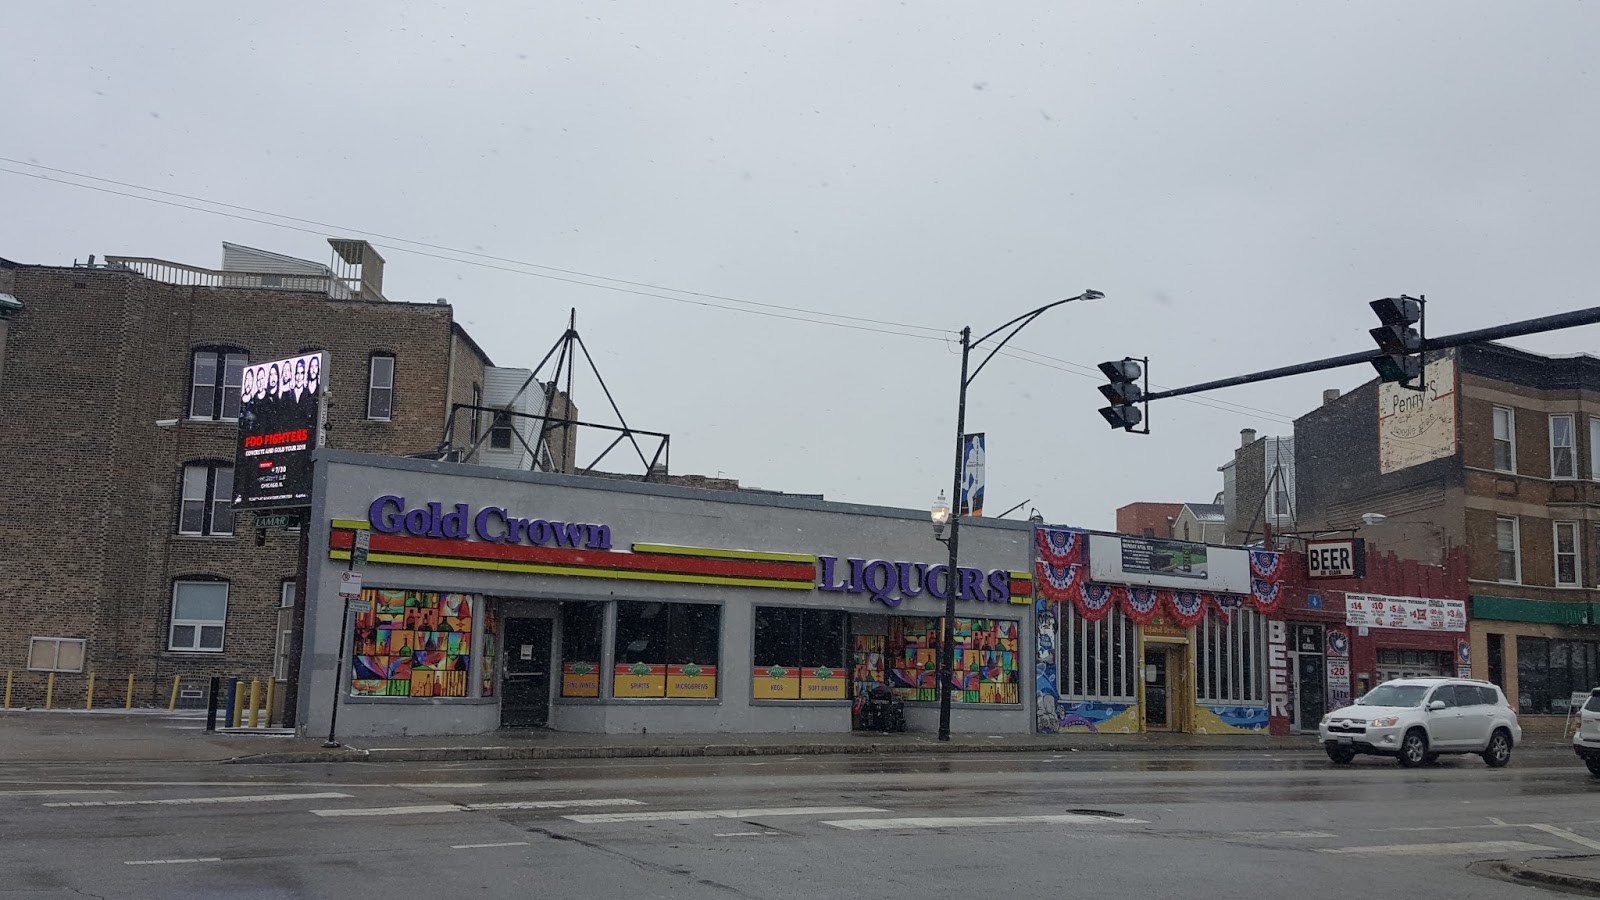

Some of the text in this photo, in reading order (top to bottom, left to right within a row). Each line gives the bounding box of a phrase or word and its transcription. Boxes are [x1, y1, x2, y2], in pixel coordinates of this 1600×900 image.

[245, 429, 308, 448] FOO FIGHTERS
[255, 516, 286, 527] LAMAR
[368, 494, 614, 550] Gold Crown
[1309, 547, 1351, 571] BEER
[817, 554, 1011, 608] LIQUORS
[1351, 602, 1363, 610] $14
[1371, 602, 1384, 610] $10
[1389, 605, 1397, 613] $5
[1269, 621, 1289, 717] BEER
[1330, 668, 1345, 676] $20
[579, 681, 596, 689] WINES
[1332, 689, 1349, 700] Lite
